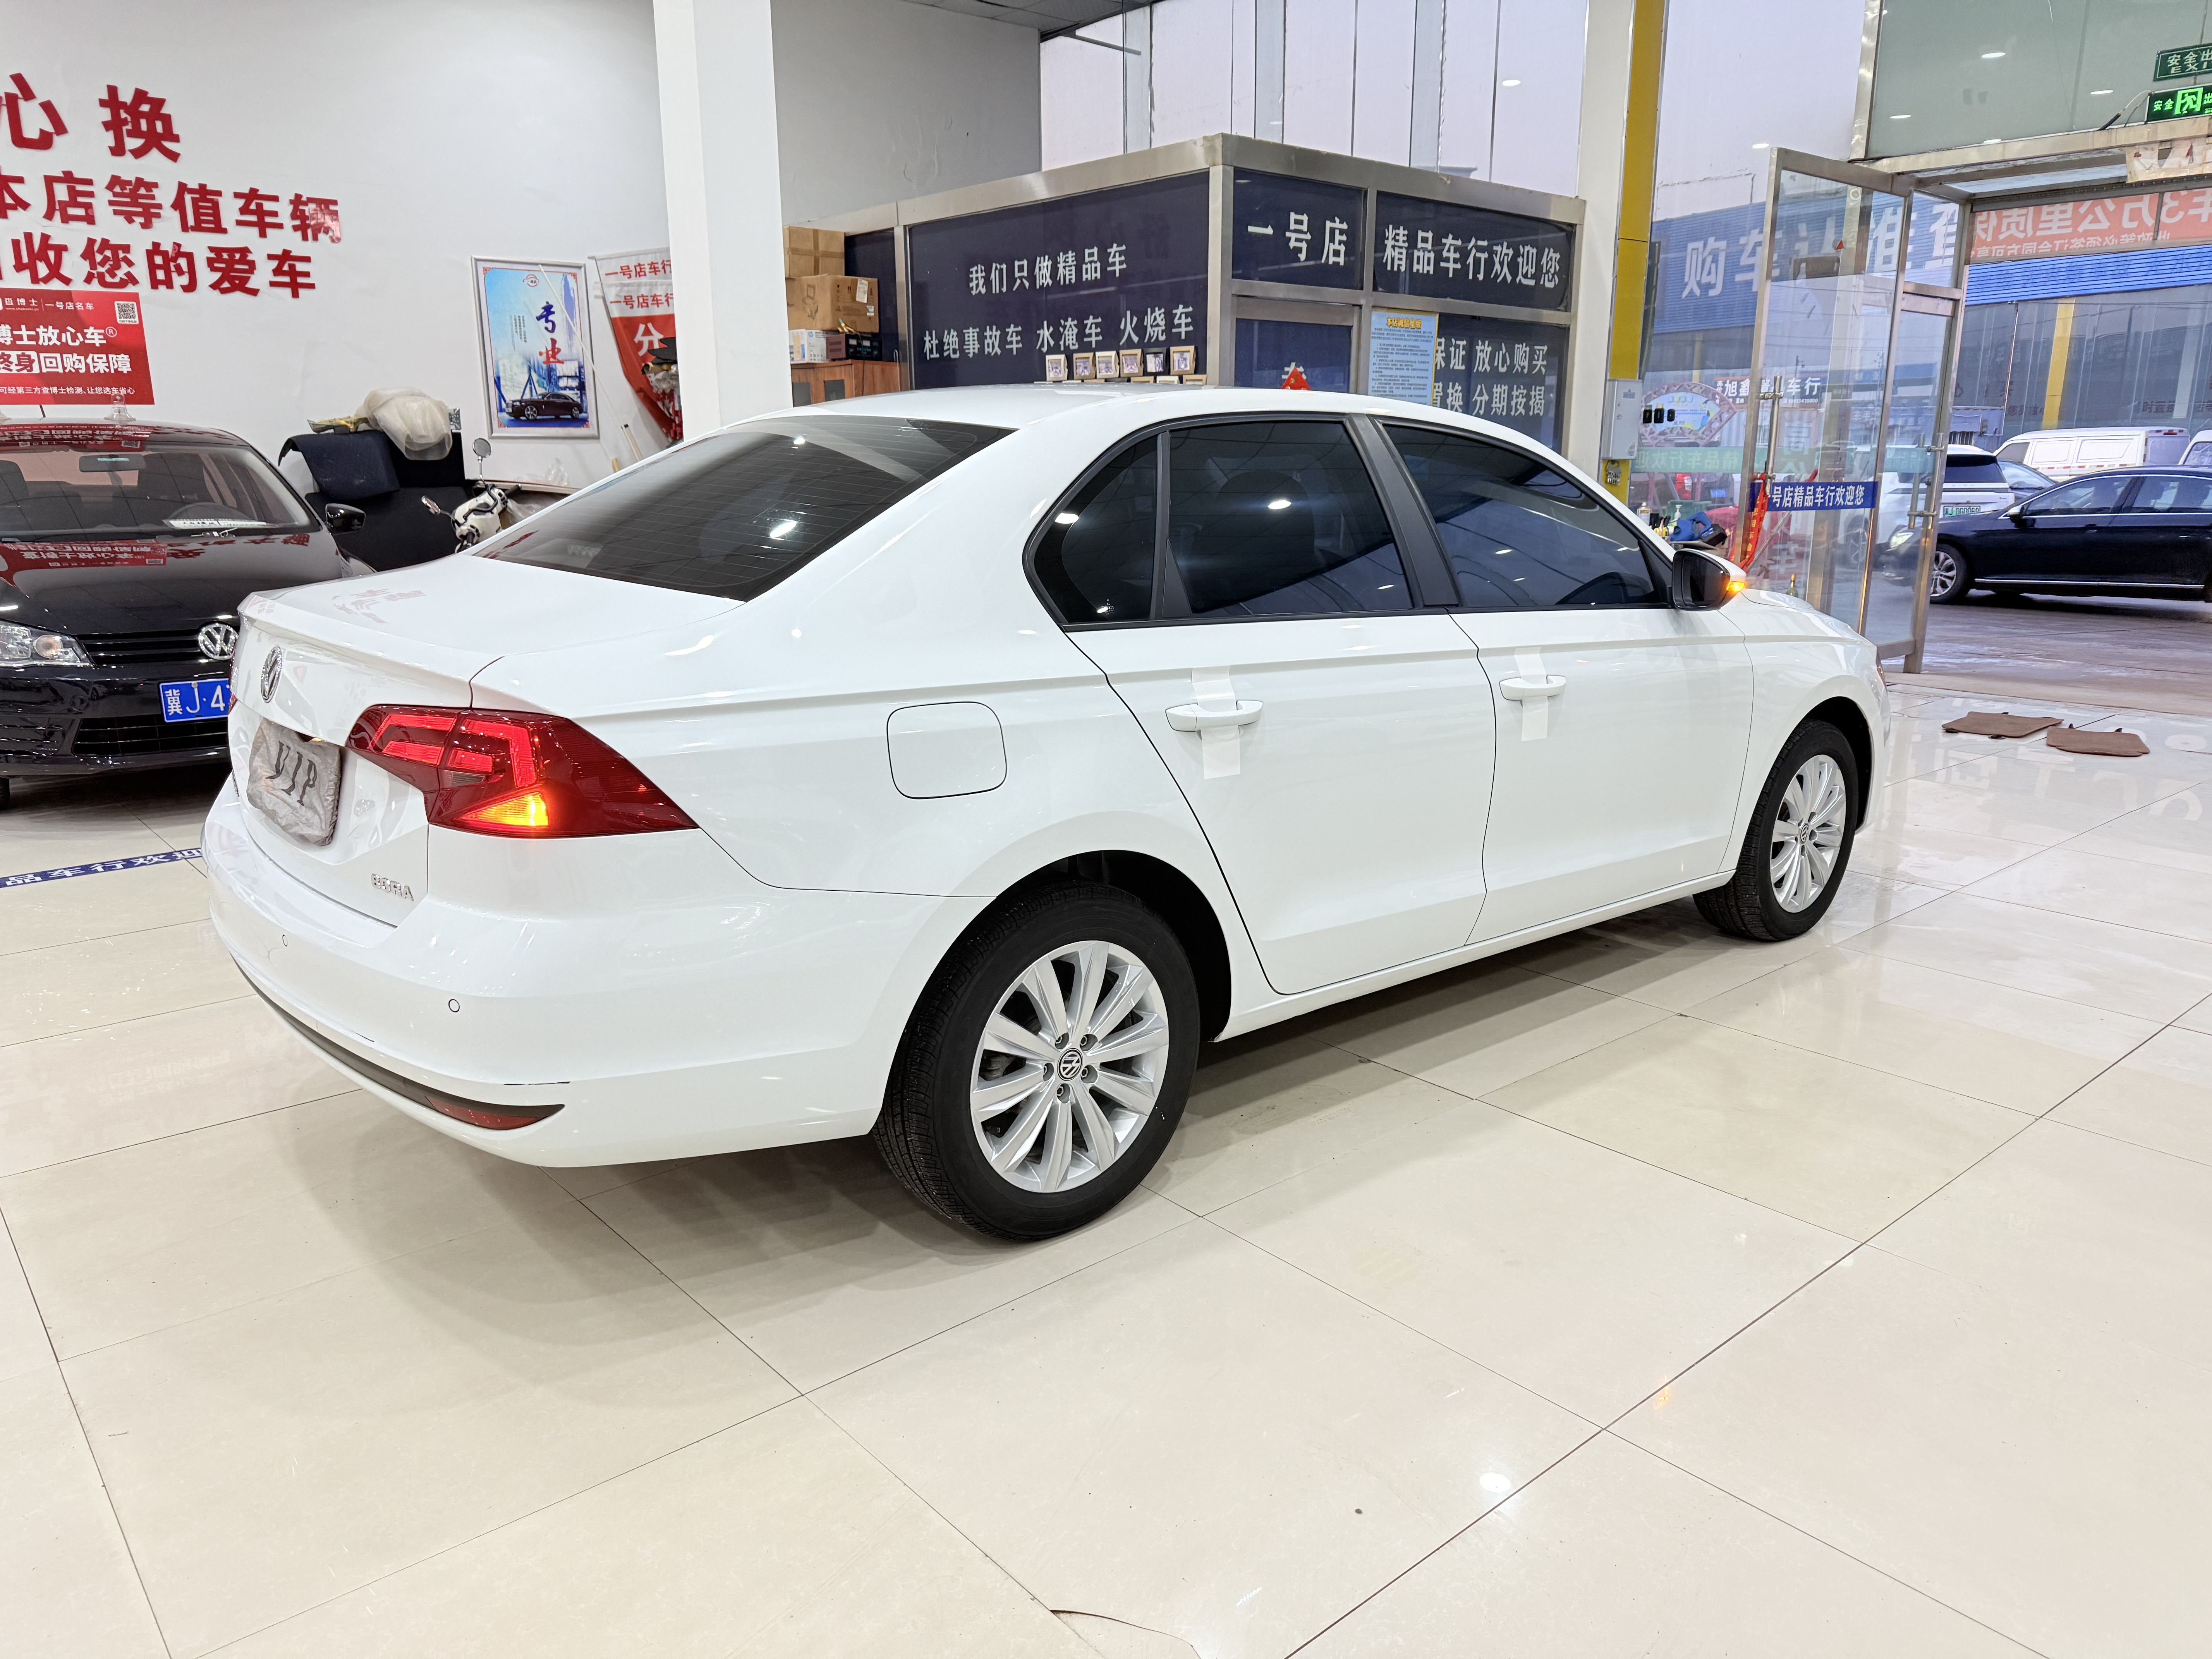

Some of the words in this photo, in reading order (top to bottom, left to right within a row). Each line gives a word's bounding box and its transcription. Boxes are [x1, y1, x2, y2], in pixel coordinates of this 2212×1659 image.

[2171, 61, 2212, 74] EXI
[2154, 98, 2174, 112] 安全
[1247, 211, 1348, 266] 一号店
[1383, 223, 1561, 289] 精品车行欢迎您
[0, 232, 316, 299] 收您的爱车
[605, 259, 672, 279] 一号店车行
[969, 243, 1127, 295] 我们只做精品车
[5, 298, 38, 307] 查博士
[45, 301, 94, 311] 一号店名车
[634, 322, 664, 357] 分
[924, 323, 1023, 361] 杜绝事故车
[1036, 315, 1103, 353] 水淹车
[1119, 304, 1194, 346] 火烧车
[1474, 340, 1548, 375] 放心购买
[1472, 383, 1545, 416] 分期按揭
[1768, 484, 1865, 508] 号店精品车行欢迎您
[165, 684, 230, 716] 冀J·4
[265, 740, 319, 807] VIP
[6, 849, 202, 886] 品车行欢迎
[371, 873, 414, 902] BORA
